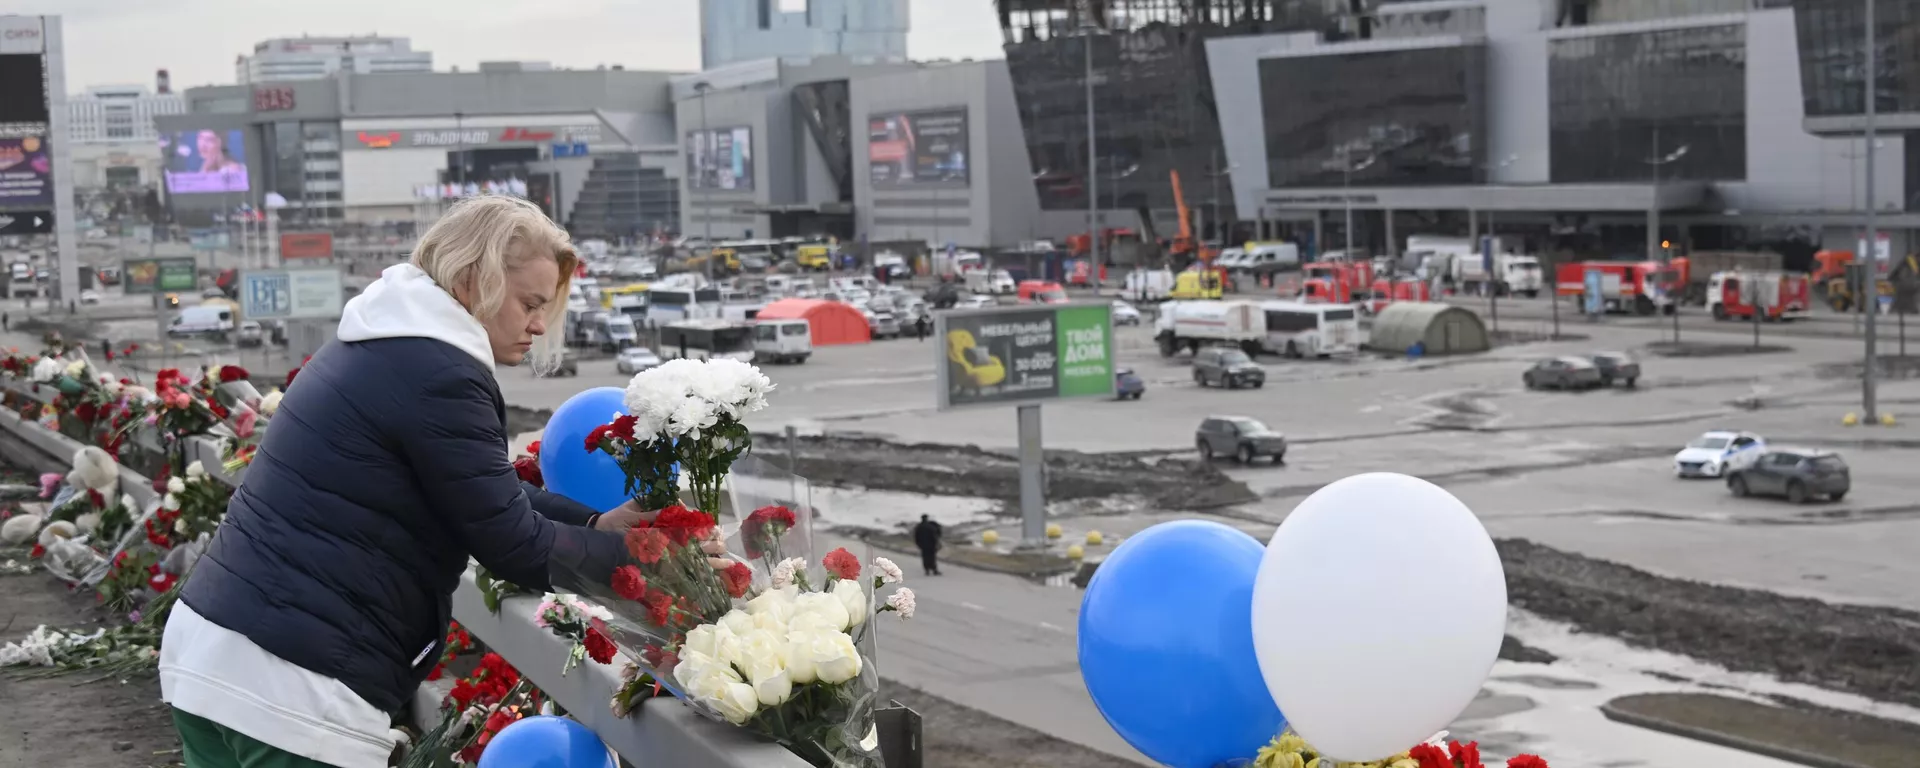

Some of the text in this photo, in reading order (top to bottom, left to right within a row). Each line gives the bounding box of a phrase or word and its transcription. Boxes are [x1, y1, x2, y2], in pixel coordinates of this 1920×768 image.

[980, 319, 1052, 337] МЕБЕЛЬНЫЙ
[1065, 325, 1103, 343] ТВОЙ
[1016, 334, 1052, 346] ЦЕНТР
[1065, 345, 1104, 363] ДОМ
